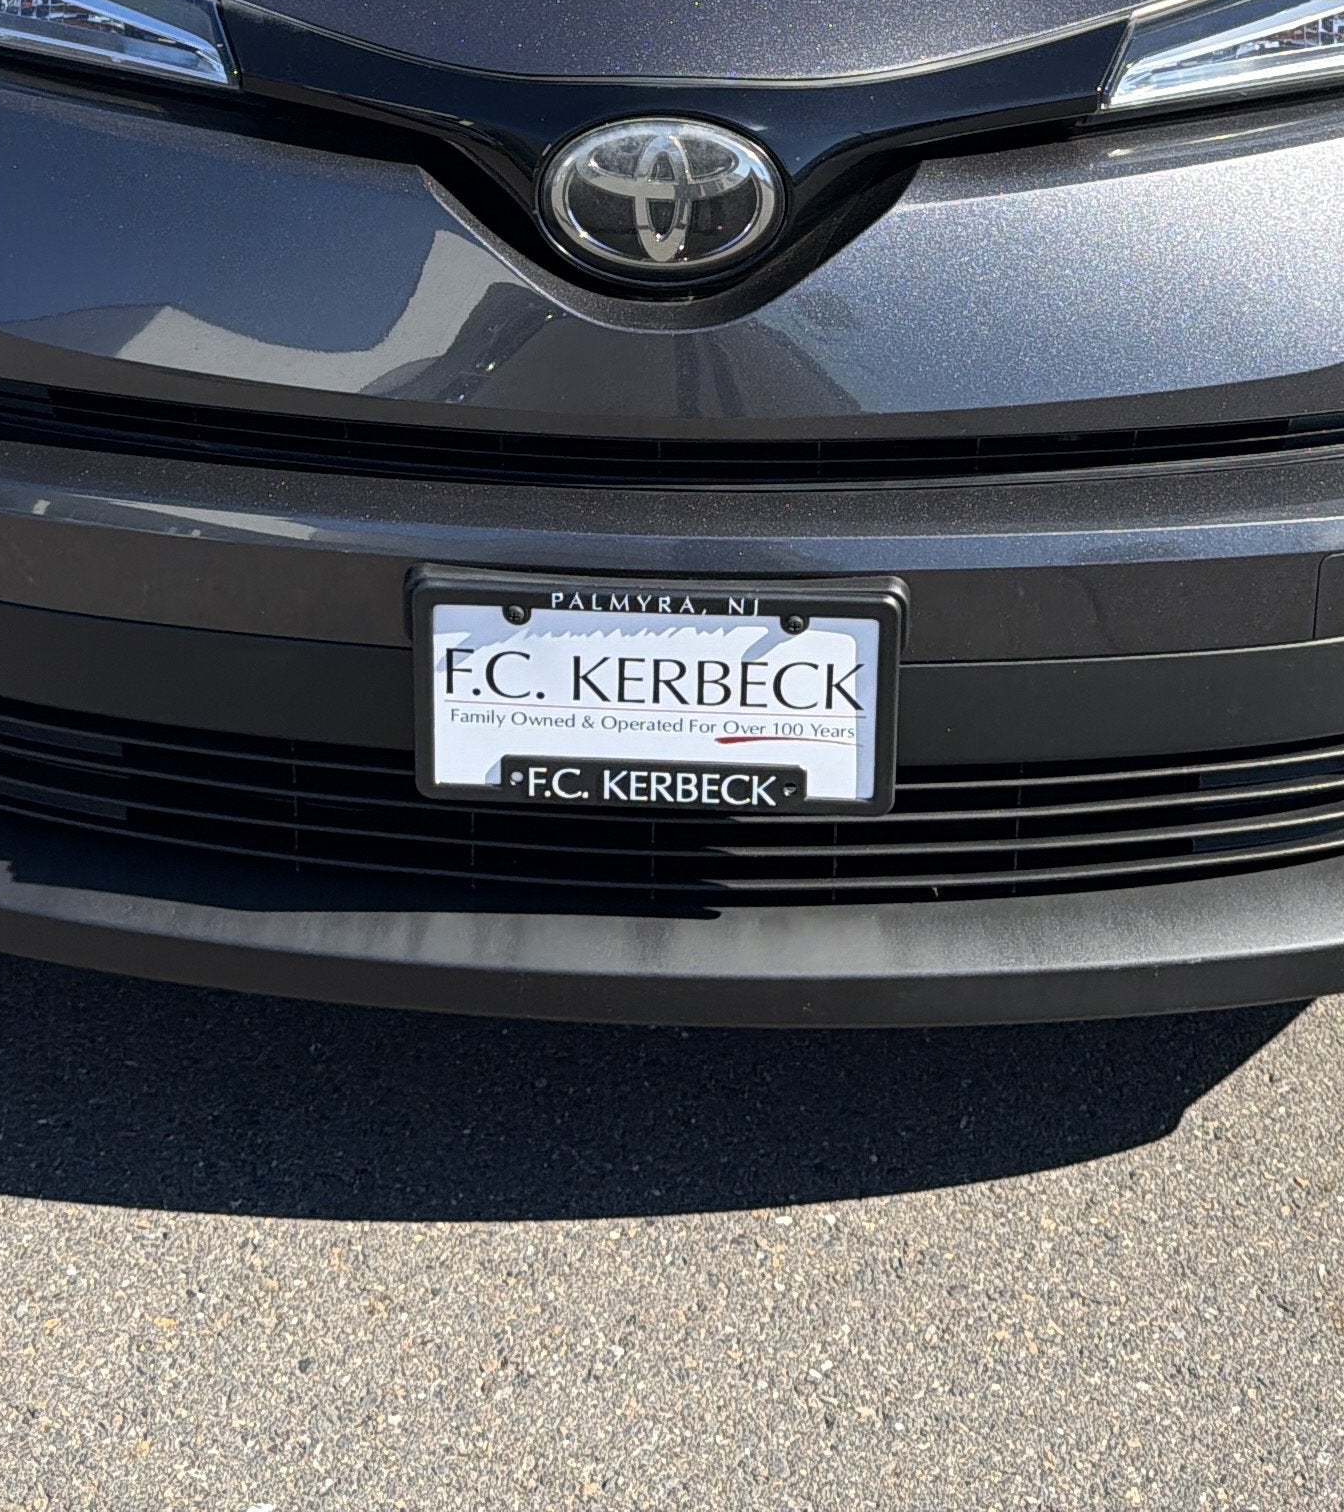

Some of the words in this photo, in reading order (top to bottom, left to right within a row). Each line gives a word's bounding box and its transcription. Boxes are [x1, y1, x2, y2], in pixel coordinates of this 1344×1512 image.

[551, 592, 707, 616] PALMYRA,
[728, 596, 759, 617] NJ
[445, 647, 546, 699] F.C.
[572, 655, 865, 712] KERBECK
[450, 708, 506, 729] Family
[511, 711, 576, 729] Owned
[581, 715, 595, 729] &
[601, 714, 683, 735] Operated
[689, 719, 717, 734] For
[723, 720, 767, 735] Over
[772, 722, 804, 737] 100
[810, 723, 855, 739] Years
[528, 767, 589, 799] F.C.
[603, 769, 777, 807] KERBECK
